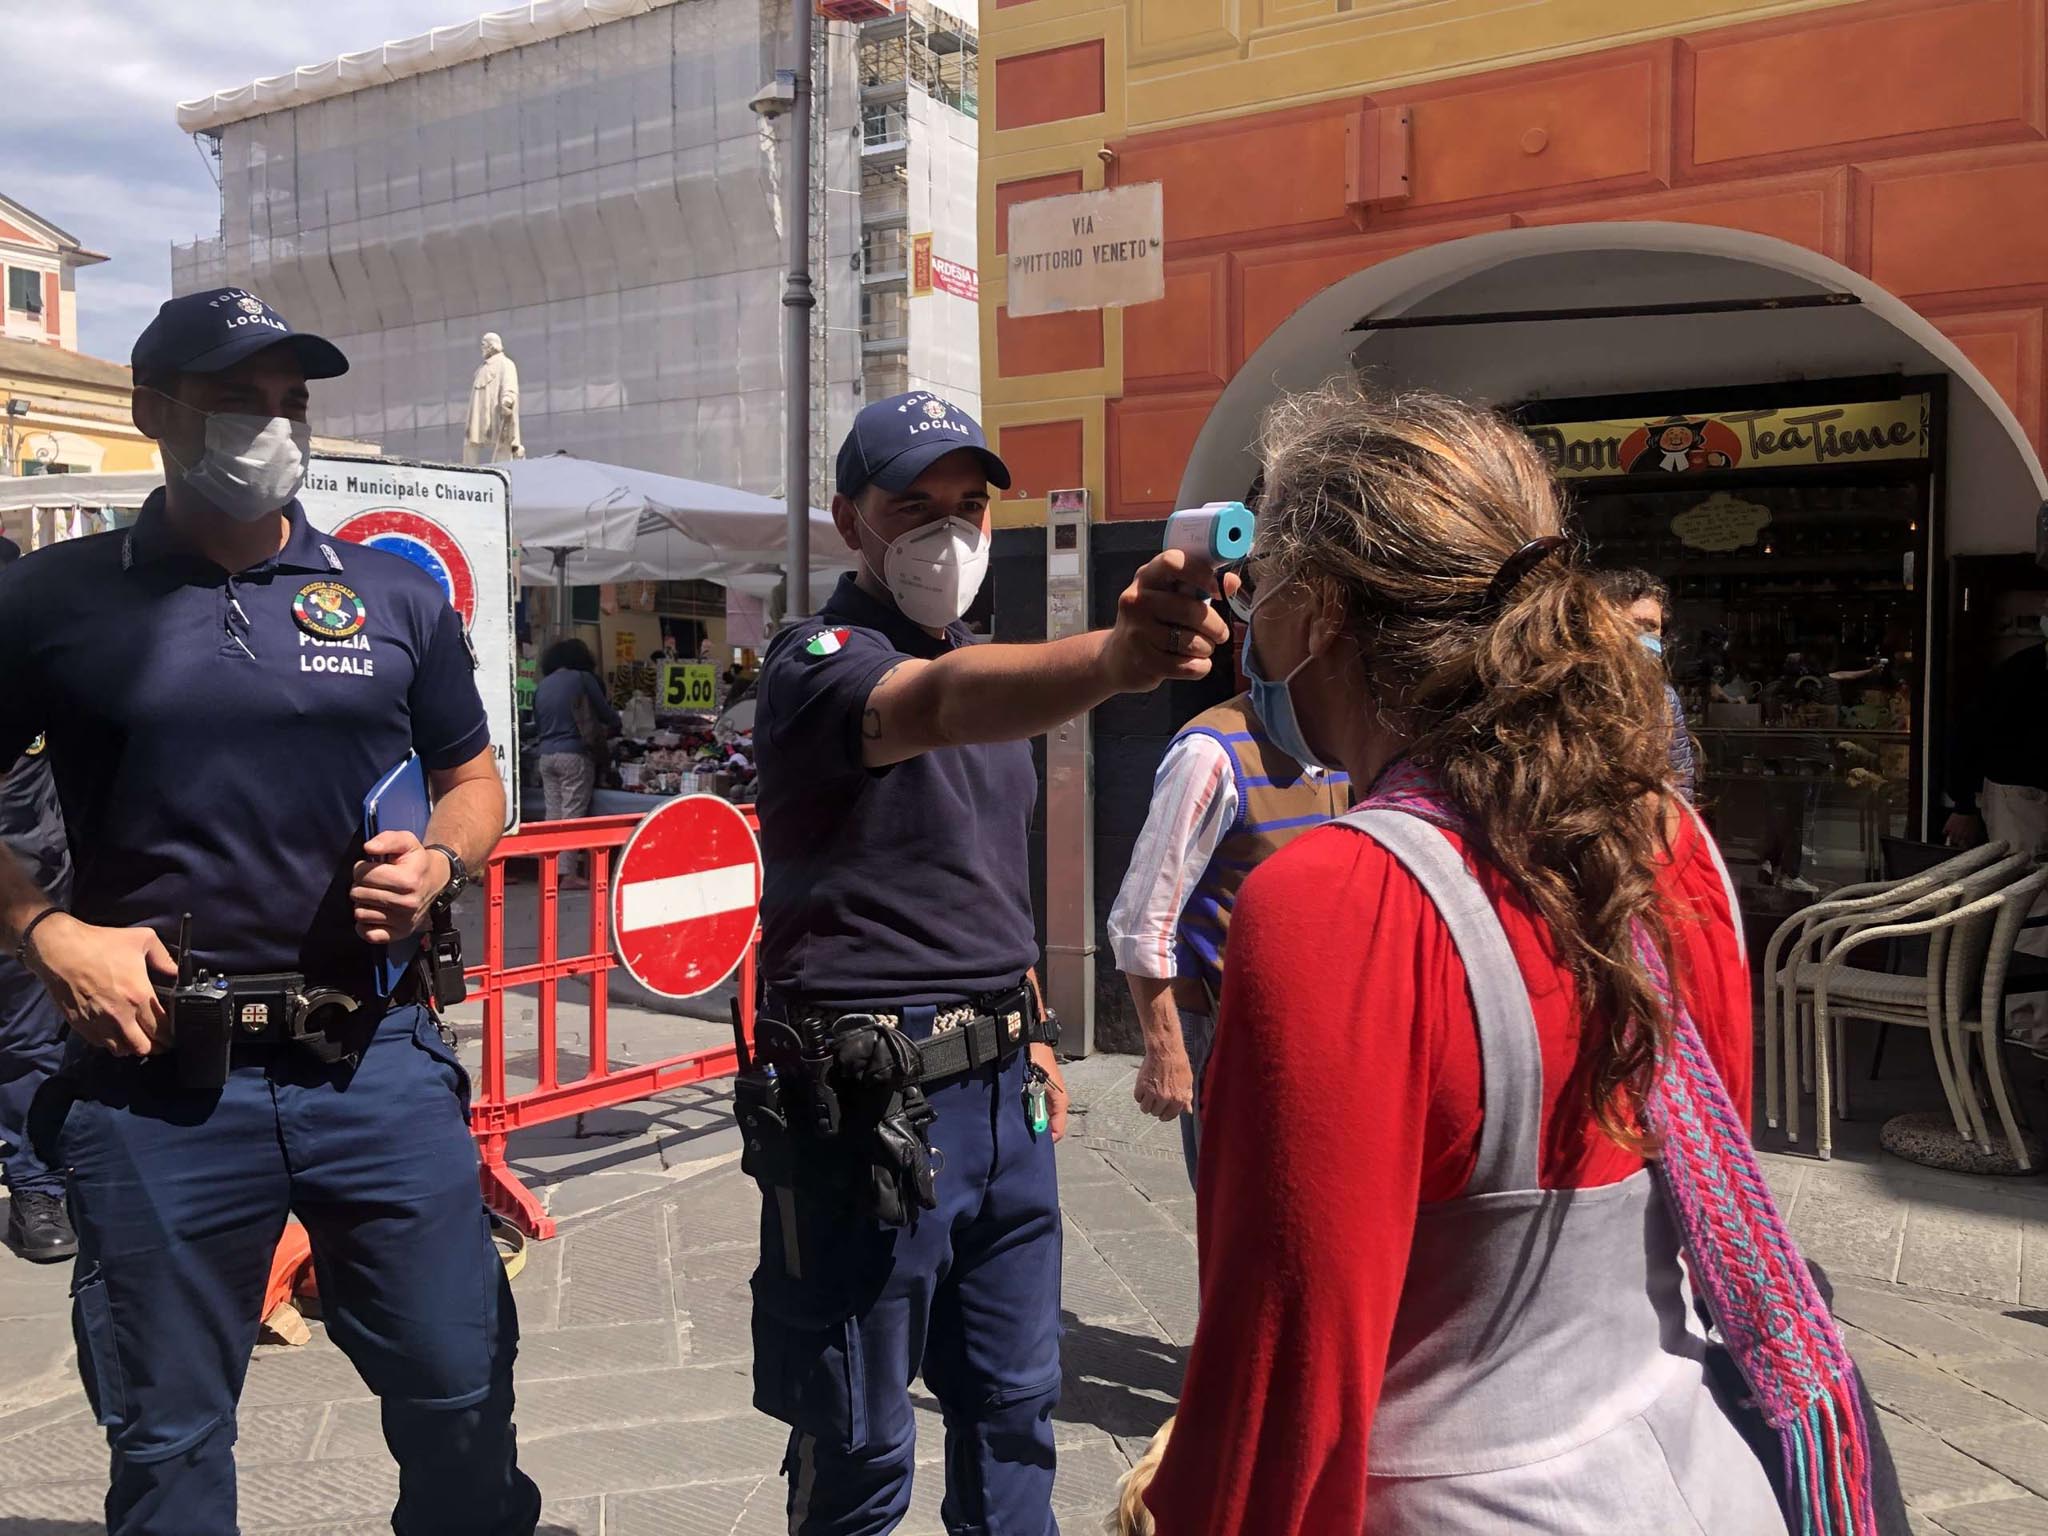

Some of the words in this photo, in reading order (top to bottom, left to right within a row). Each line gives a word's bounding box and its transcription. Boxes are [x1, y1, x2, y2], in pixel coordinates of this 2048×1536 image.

[1072, 215, 1094, 236] VIA
[1023, 248, 1083, 274] VITTORIO
[1093, 239, 1147, 265] VENETO
[932, 257, 972, 284] ARDESIA
[227, 315, 288, 332] LOCALE
[909, 420, 969, 435] LOCALE
[1526, 426, 1622, 473] Don
[1719, 408, 1813, 460] Tea
[1783, 408, 1917, 463] Time
[304, 473, 338, 492] lizia
[347, 477, 429, 500] Municipale
[435, 483, 494, 503] Chiavari
[300, 654, 374, 677] LOCALE
[667, 666, 712, 704] 5.00
